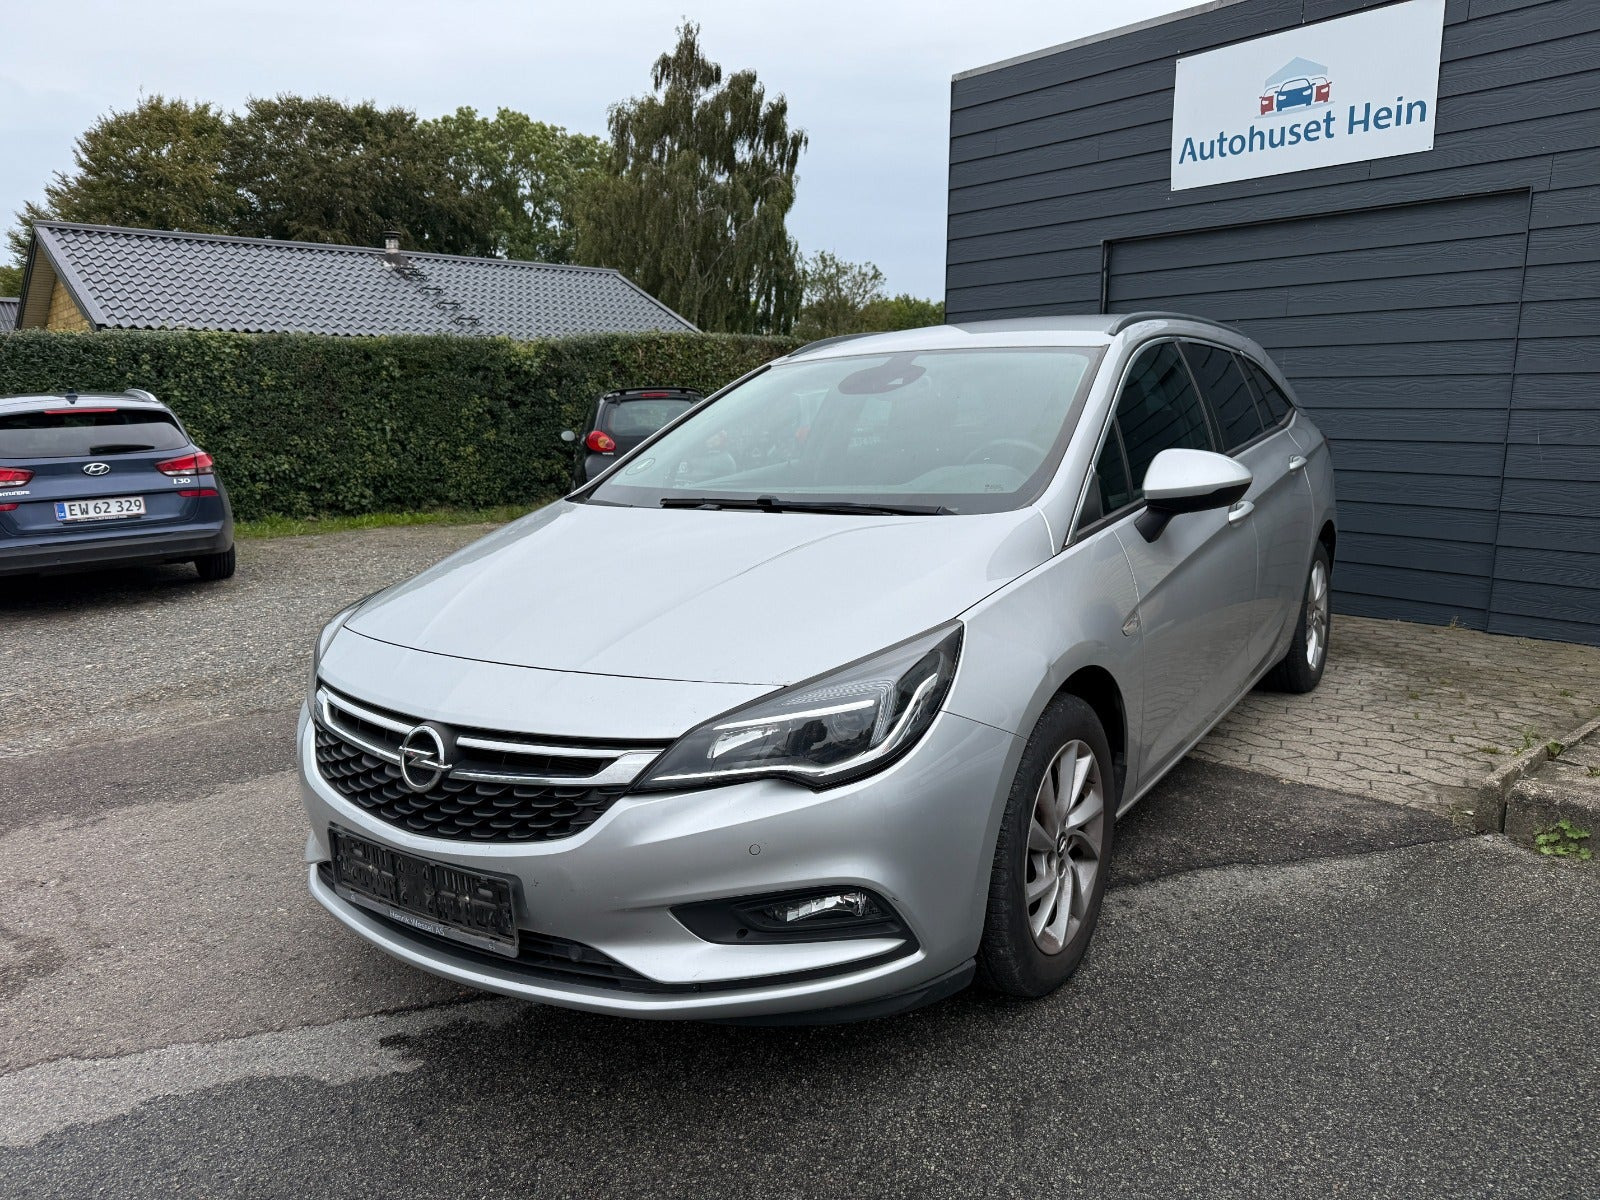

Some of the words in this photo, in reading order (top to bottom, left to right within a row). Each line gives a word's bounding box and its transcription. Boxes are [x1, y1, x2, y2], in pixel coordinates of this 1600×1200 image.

[1178, 110, 1336, 165] Autohuset
[1347, 96, 1427, 135] Hein
[68, 502, 89, 516] EW
[93, 501, 112, 514] 62
[115, 499, 142, 513] 329
